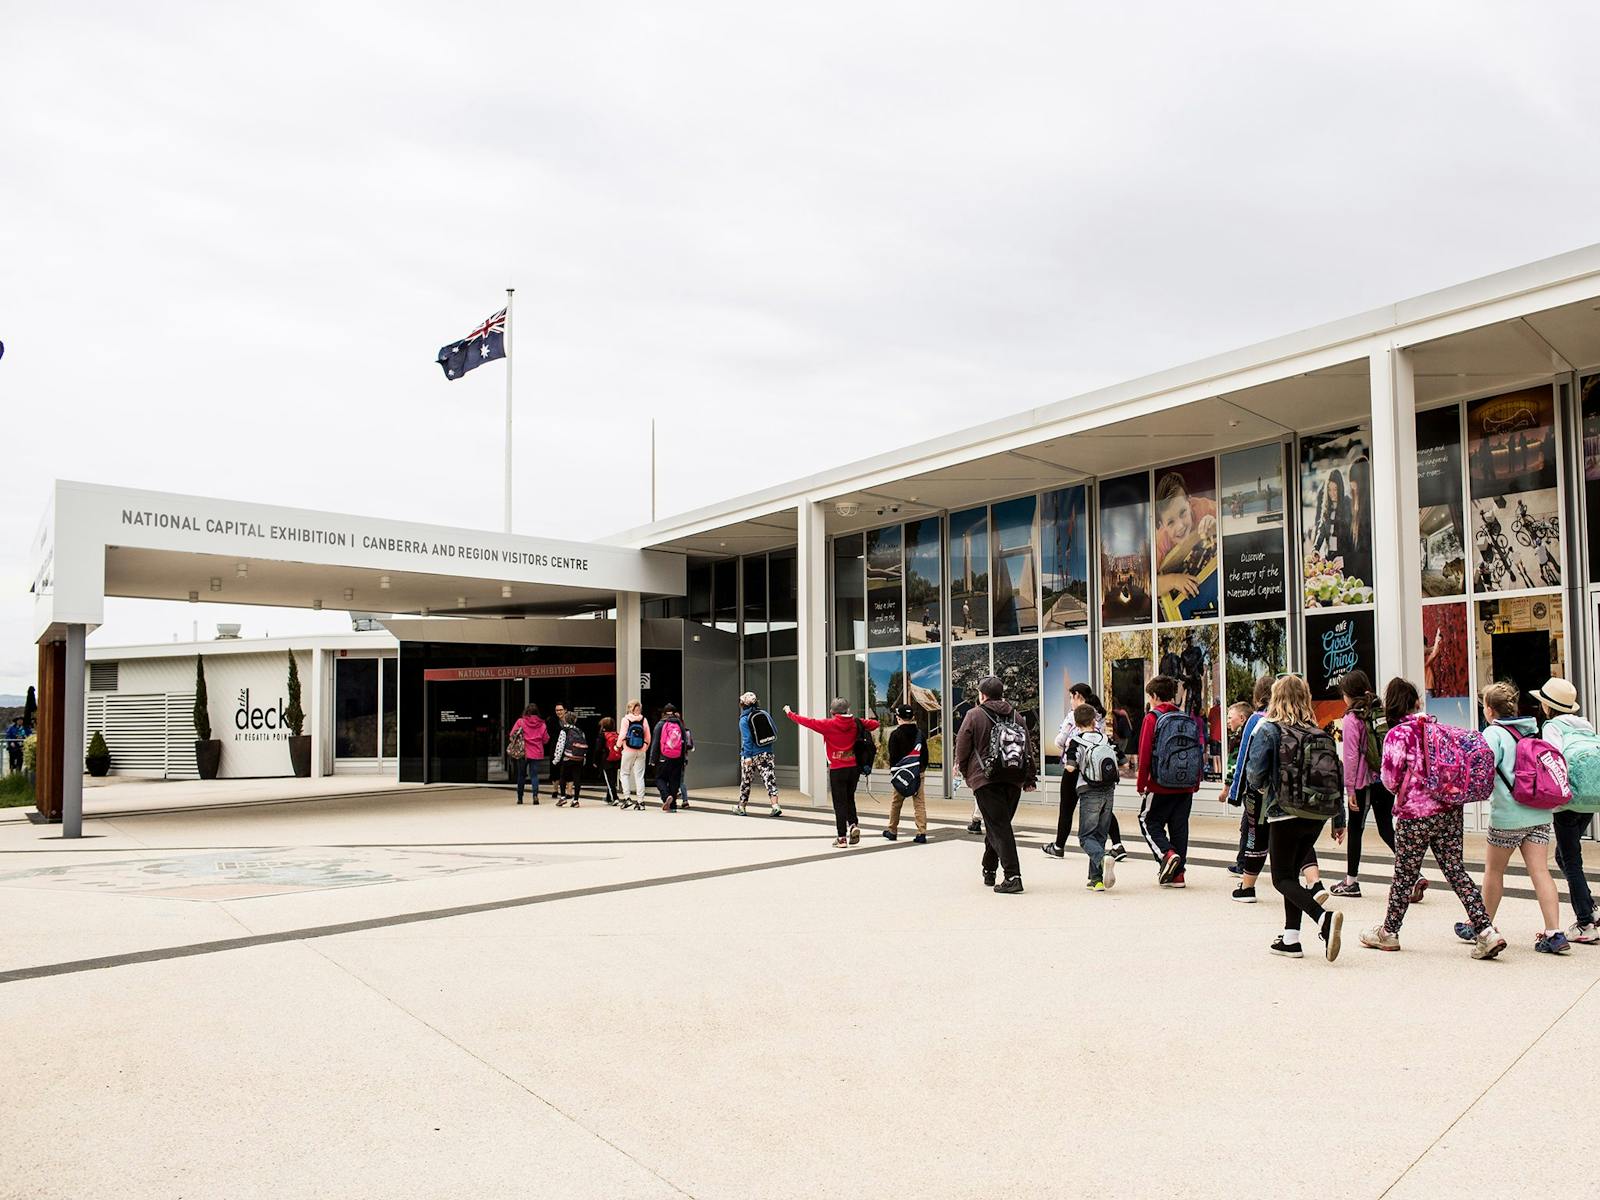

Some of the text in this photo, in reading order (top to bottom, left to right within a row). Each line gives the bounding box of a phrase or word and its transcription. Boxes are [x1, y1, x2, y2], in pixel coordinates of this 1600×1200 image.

[121, 509, 589, 571] NATIONAL CAPITAL EXHIBITION CANBERRA AND REGION VISITORS CENTRE
[1240, 552, 1266, 562] Discover
[1229, 563, 1279, 584] the story of the
[1226, 581, 1283, 600] National Capital
[1335, 620, 1347, 632] ONE
[1321, 620, 1357, 653] Good
[458, 666, 576, 678] NATIONAL CAPITAL EXHIBITION
[1323, 651, 1358, 678] Thing
[237, 688, 246, 707] the
[235, 688, 291, 730] deck
[235, 733, 241, 741] AT
[244, 733, 270, 741] REGATTA
